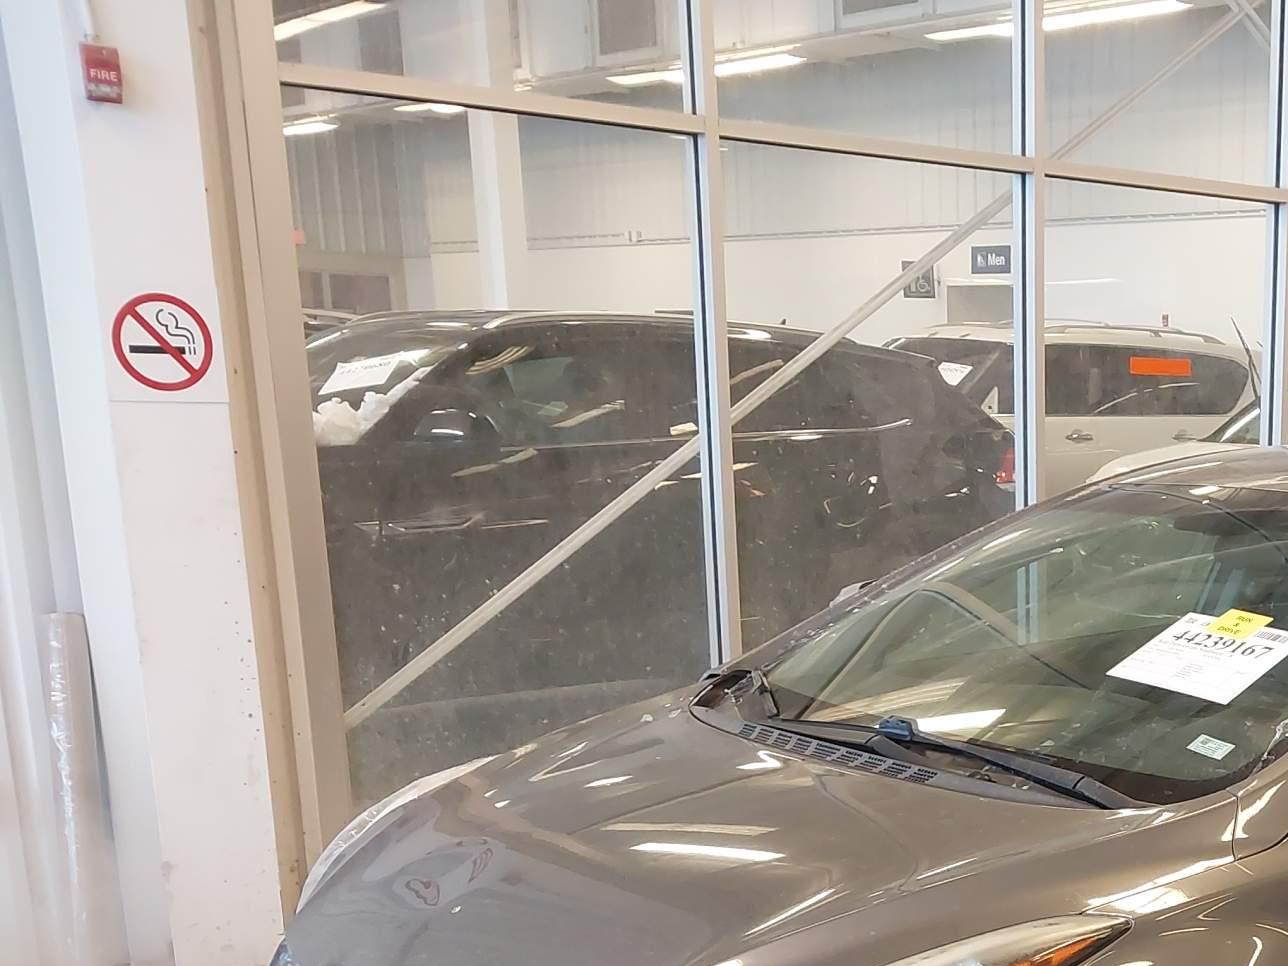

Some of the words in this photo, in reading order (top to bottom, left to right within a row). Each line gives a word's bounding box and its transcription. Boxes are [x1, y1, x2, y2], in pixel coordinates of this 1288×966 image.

[90, 68, 118, 82] FIRE
[987, 252, 1006, 266] Men
[1172, 630, 1276, 660] 44239167
